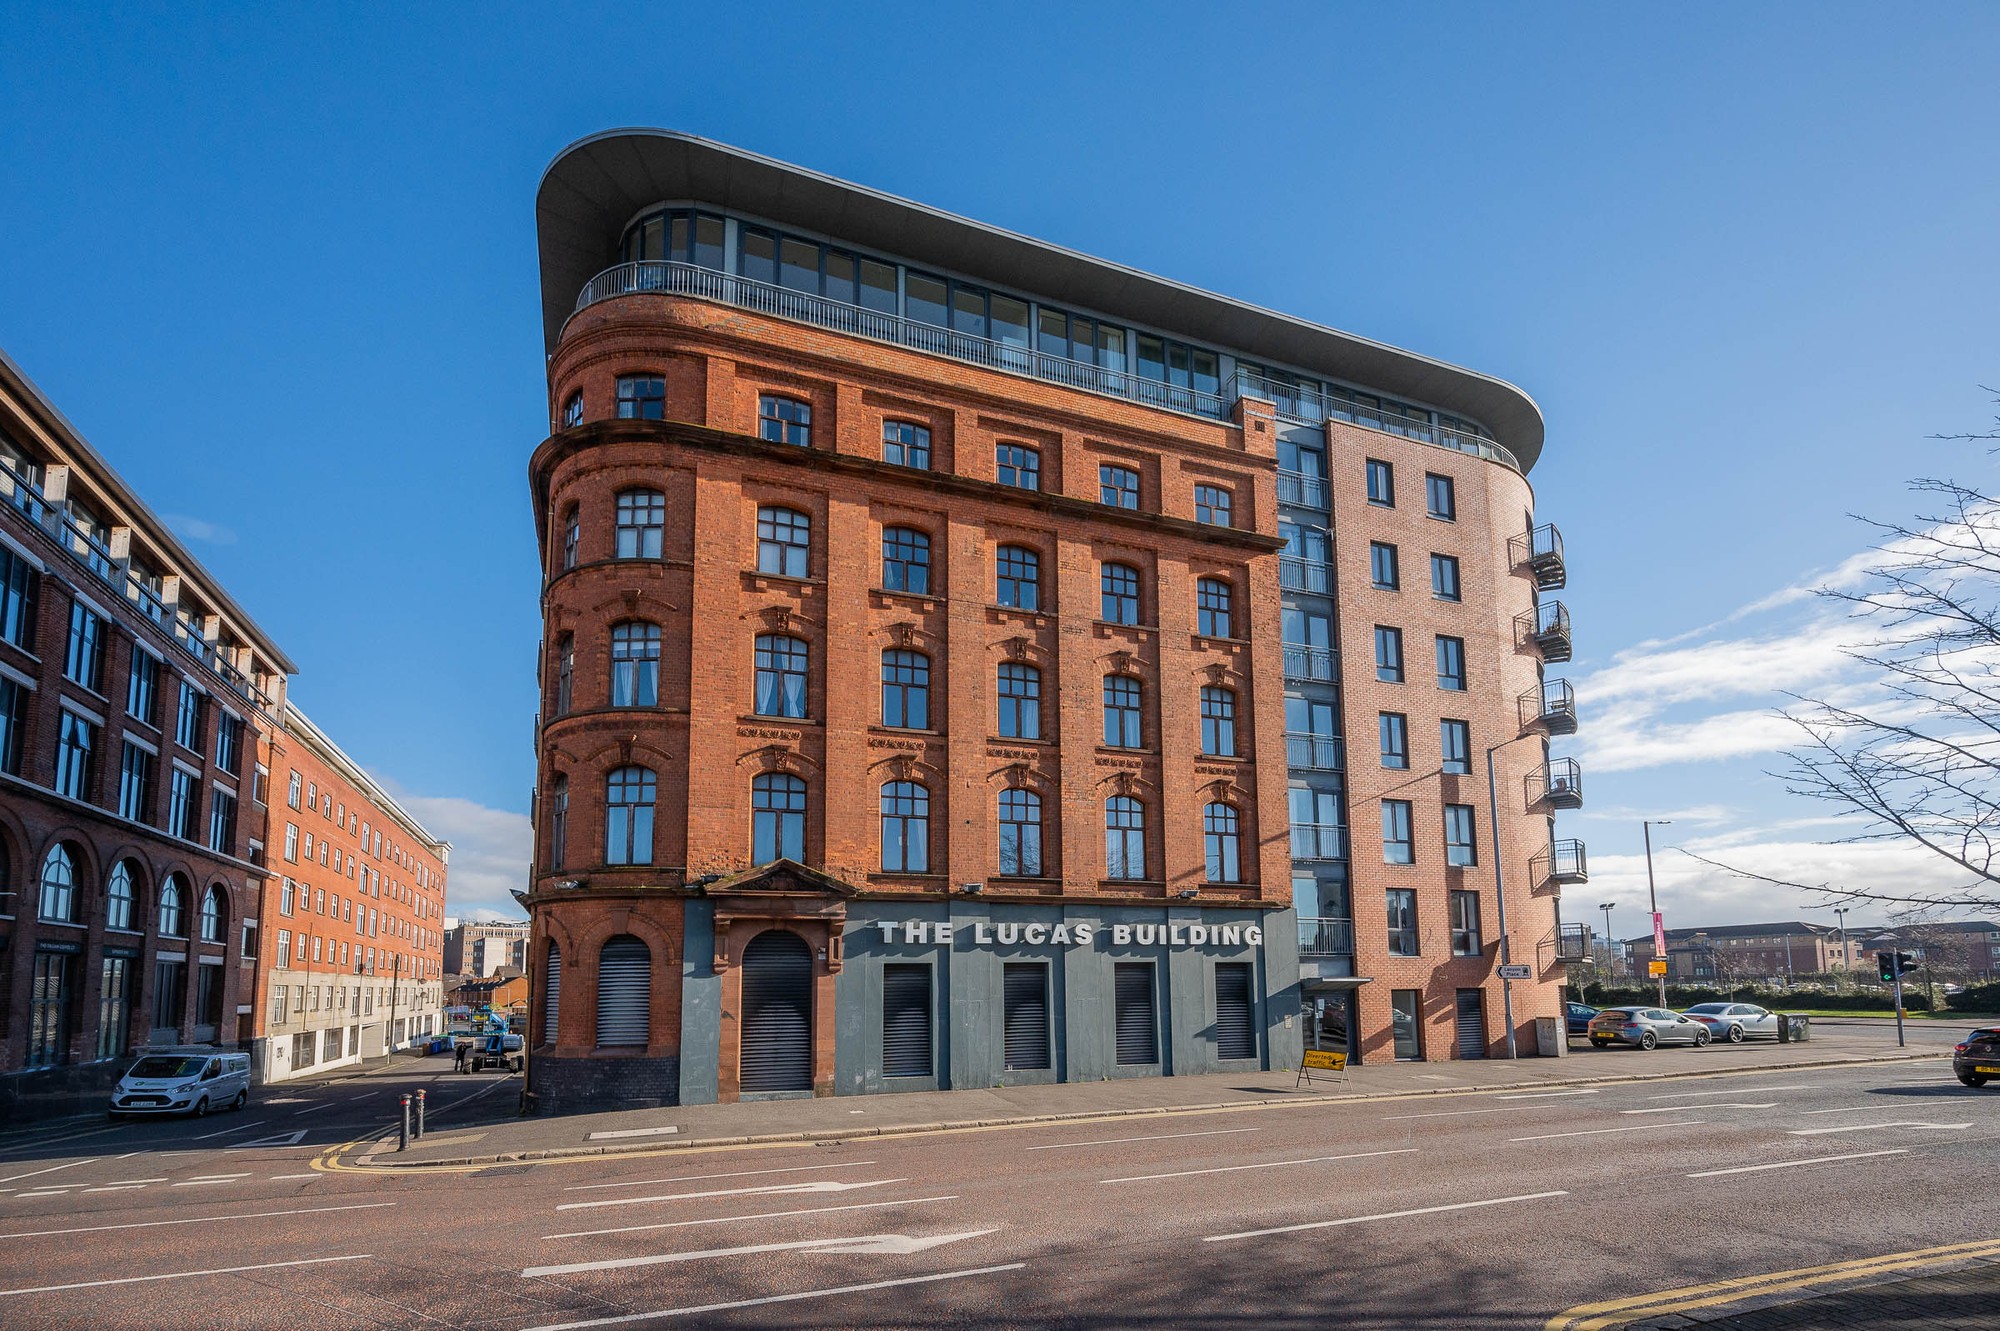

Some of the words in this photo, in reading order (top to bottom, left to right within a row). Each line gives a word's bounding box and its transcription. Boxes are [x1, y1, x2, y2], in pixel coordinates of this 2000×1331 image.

[878, 921, 953, 944] THE
[975, 923, 1094, 945] LUCAS
[1112, 924, 1263, 946] BUILDING
[1306, 1052, 1332, 1060] Diverted
